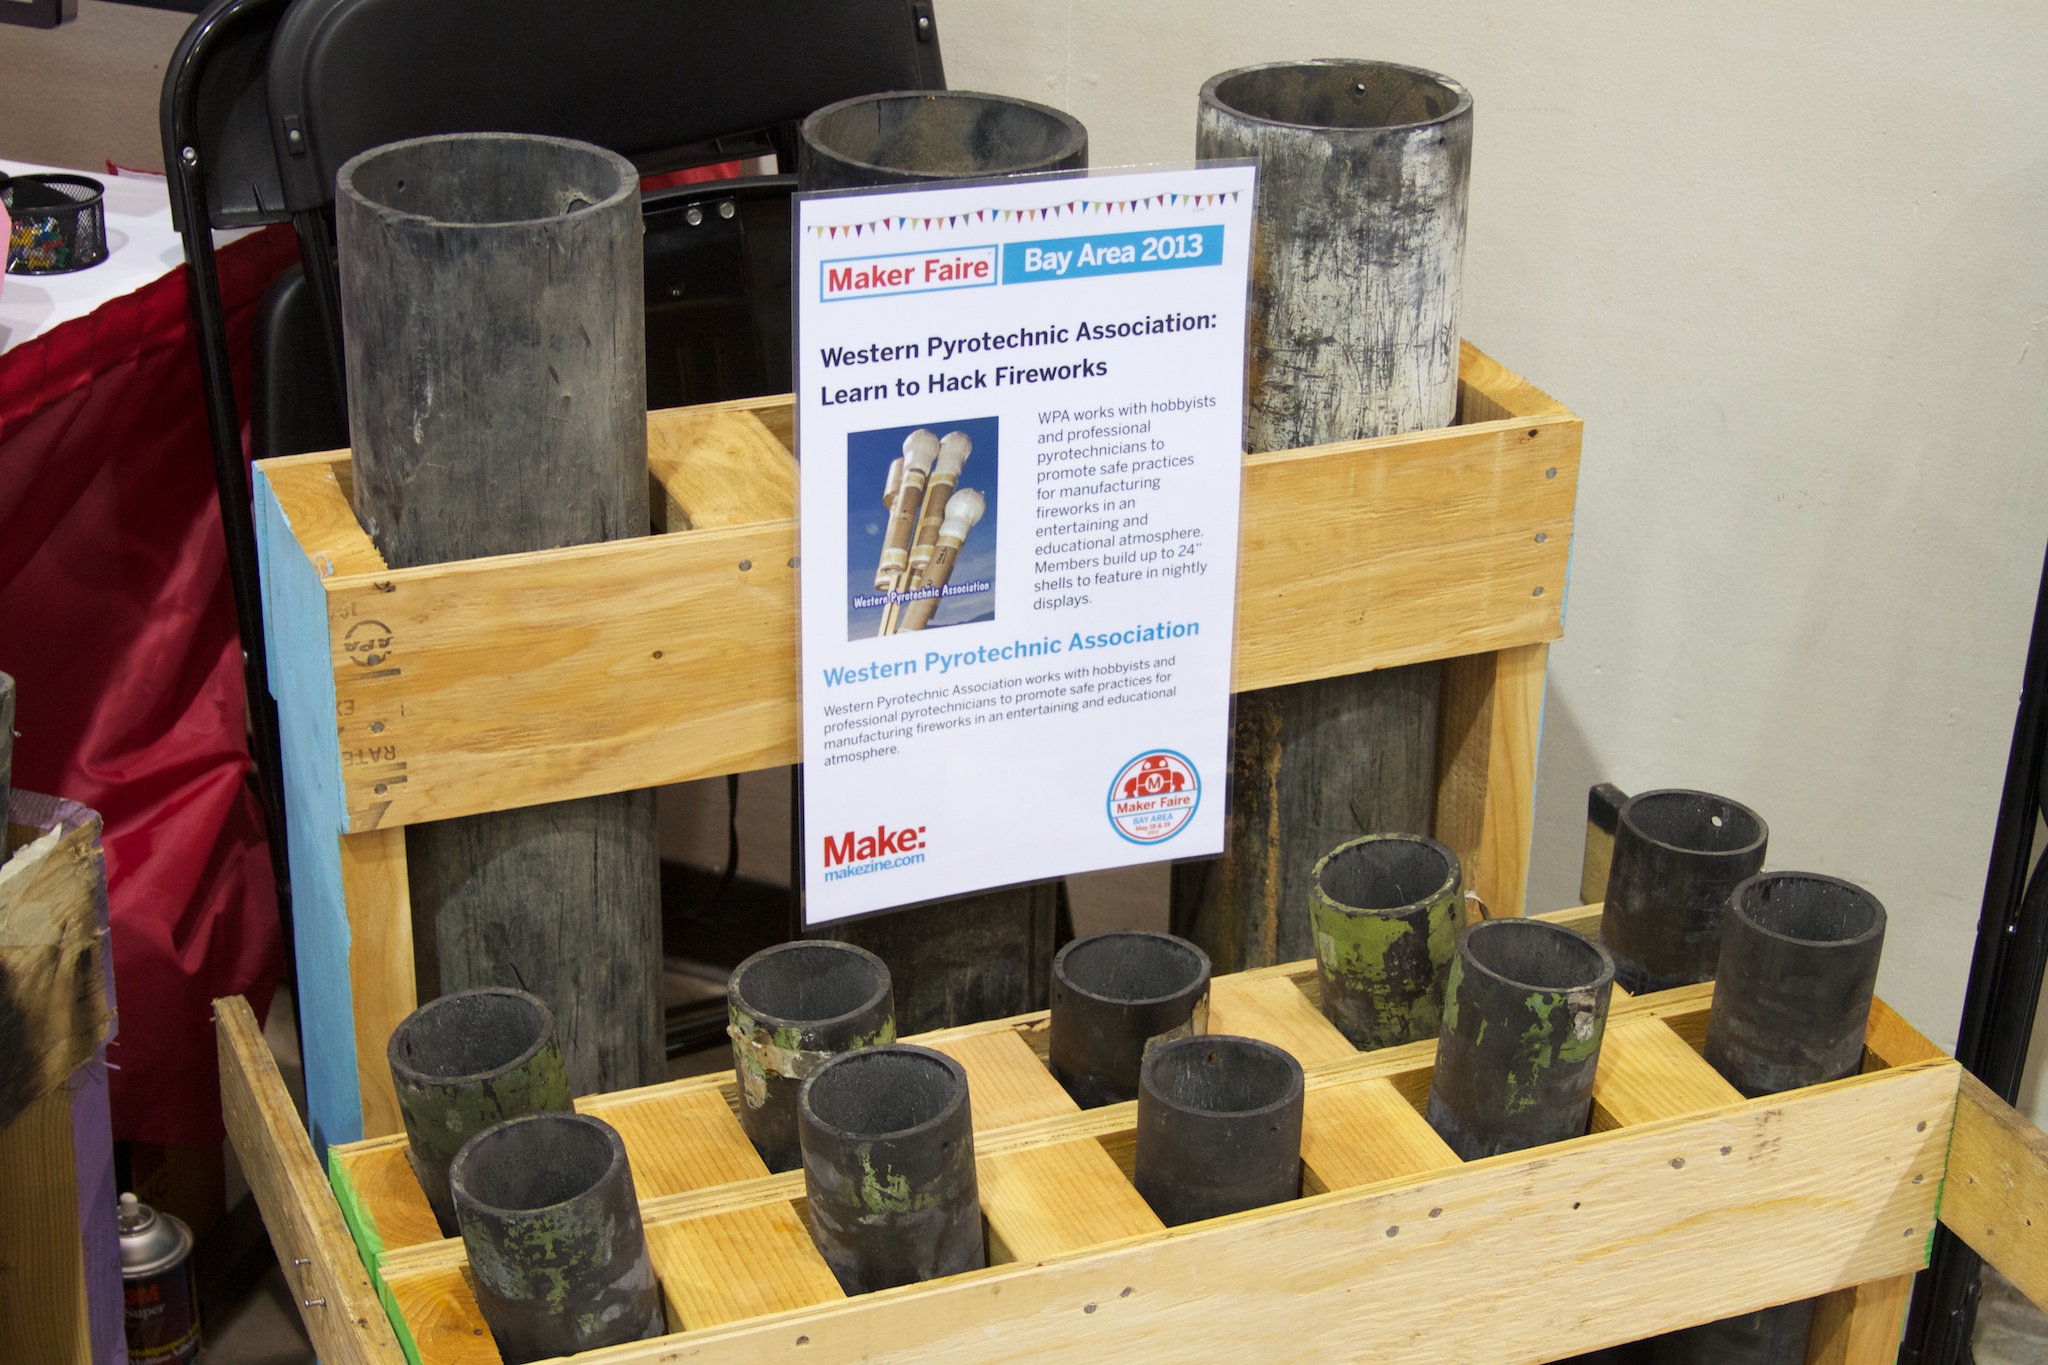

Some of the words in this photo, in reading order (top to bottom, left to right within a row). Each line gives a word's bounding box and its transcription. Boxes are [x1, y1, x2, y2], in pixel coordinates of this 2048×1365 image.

[827, 258, 915, 293] Maker
[924, 257, 989, 283] Faire
[1025, 247, 1073, 275] Bay
[1076, 243, 1136, 267] Area
[1141, 233, 1204, 261] 2013
[820, 343, 919, 368] Western
[928, 325, 1069, 360] Pyrotechnic
[1076, 313, 1216, 341] Association:
[822, 383, 887, 406] Learn
[896, 378, 920, 397] to
[929, 369, 987, 393] Hack
[995, 358, 1108, 387] Fireworks
[1038, 410, 1070, 425] WPA
[1074, 406, 1114, 421] works
[1119, 402, 1147, 417] with
[1151, 395, 1216, 414] hobbyists
[1038, 430, 1063, 444] and
[1067, 420, 1151, 444] professional
[1037, 438, 1147, 466] pyrotechnicians
[1151, 439, 1165, 451] to
[1037, 465, 1096, 484] promote
[1100, 460, 1128, 475] safe
[1132, 454, 1195, 474] practices
[1037, 487, 1056, 500] for
[1060, 476, 1161, 498] manufacturing
[1036, 501, 1099, 519] fireworks
[1104, 499, 1115, 511] in
[1119, 498, 1136, 510] an
[1036, 518, 1119, 537] entertaining
[1123, 513, 1148, 527] and
[1035, 535, 1115, 556] educational
[1119, 526, 1204, 547] atmosphere.
[1035, 557, 1099, 574] Members
[1103, 550, 1136, 566] build
[1140, 549, 1157, 564] up
[1161, 547, 1175, 559] to
[1034, 576, 1073, 592] shells
[1077, 575, 1091, 587] to
[1095, 569, 1142, 585] feature
[1146, 567, 1158, 579] in
[1162, 560, 1208, 579] nightly
[854, 596, 888, 608] Western
[890, 586, 939, 605] Pyrotechnic
[942, 581, 990, 597] Association
[1033, 593, 1092, 610] displays.
[344, 636, 394, 652] APA
[823, 660, 917, 688] Western
[925, 637, 1061, 674] Pyrotechnic
[1069, 621, 1200, 652] Association
[824, 700, 874, 717] Western
[877, 687, 949, 709] Pyrotechnic
[952, 677, 1022, 696] Association
[1026, 671, 1061, 685] works
[1064, 665, 1089, 679] with
[1093, 659, 1150, 676] hobbyists
[1153, 655, 1176, 668] and
[824, 711, 898, 736] professional
[901, 696, 996, 723] pyrotechnicians
[1001, 693, 1012, 704] to
[1015, 686, 1066, 705] promote
[1070, 681, 1094, 696] safe
[1097, 675, 1152, 693] practices
[1155, 672, 1172, 684] for
[824, 725, 913, 750] manufacturing
[917, 716, 971, 734] fireworks
[975, 714, 985, 724] in
[988, 711, 1003, 723] an
[1006, 701, 1079, 720] entertaining
[1082, 693, 1104, 709] and
[1107, 686, 1176, 705] educational
[824, 744, 900, 766] atmosphere.
[1117, 801, 1156, 814] Maker
[1161, 796, 1190, 808] Faire
[1133, 817, 1149, 825] BAY
[1151, 813, 1173, 822] AREA
[824, 825, 926, 868] Make:
[824, 852, 925, 882] makezine.com
[125, 1303, 166, 1321] Super
